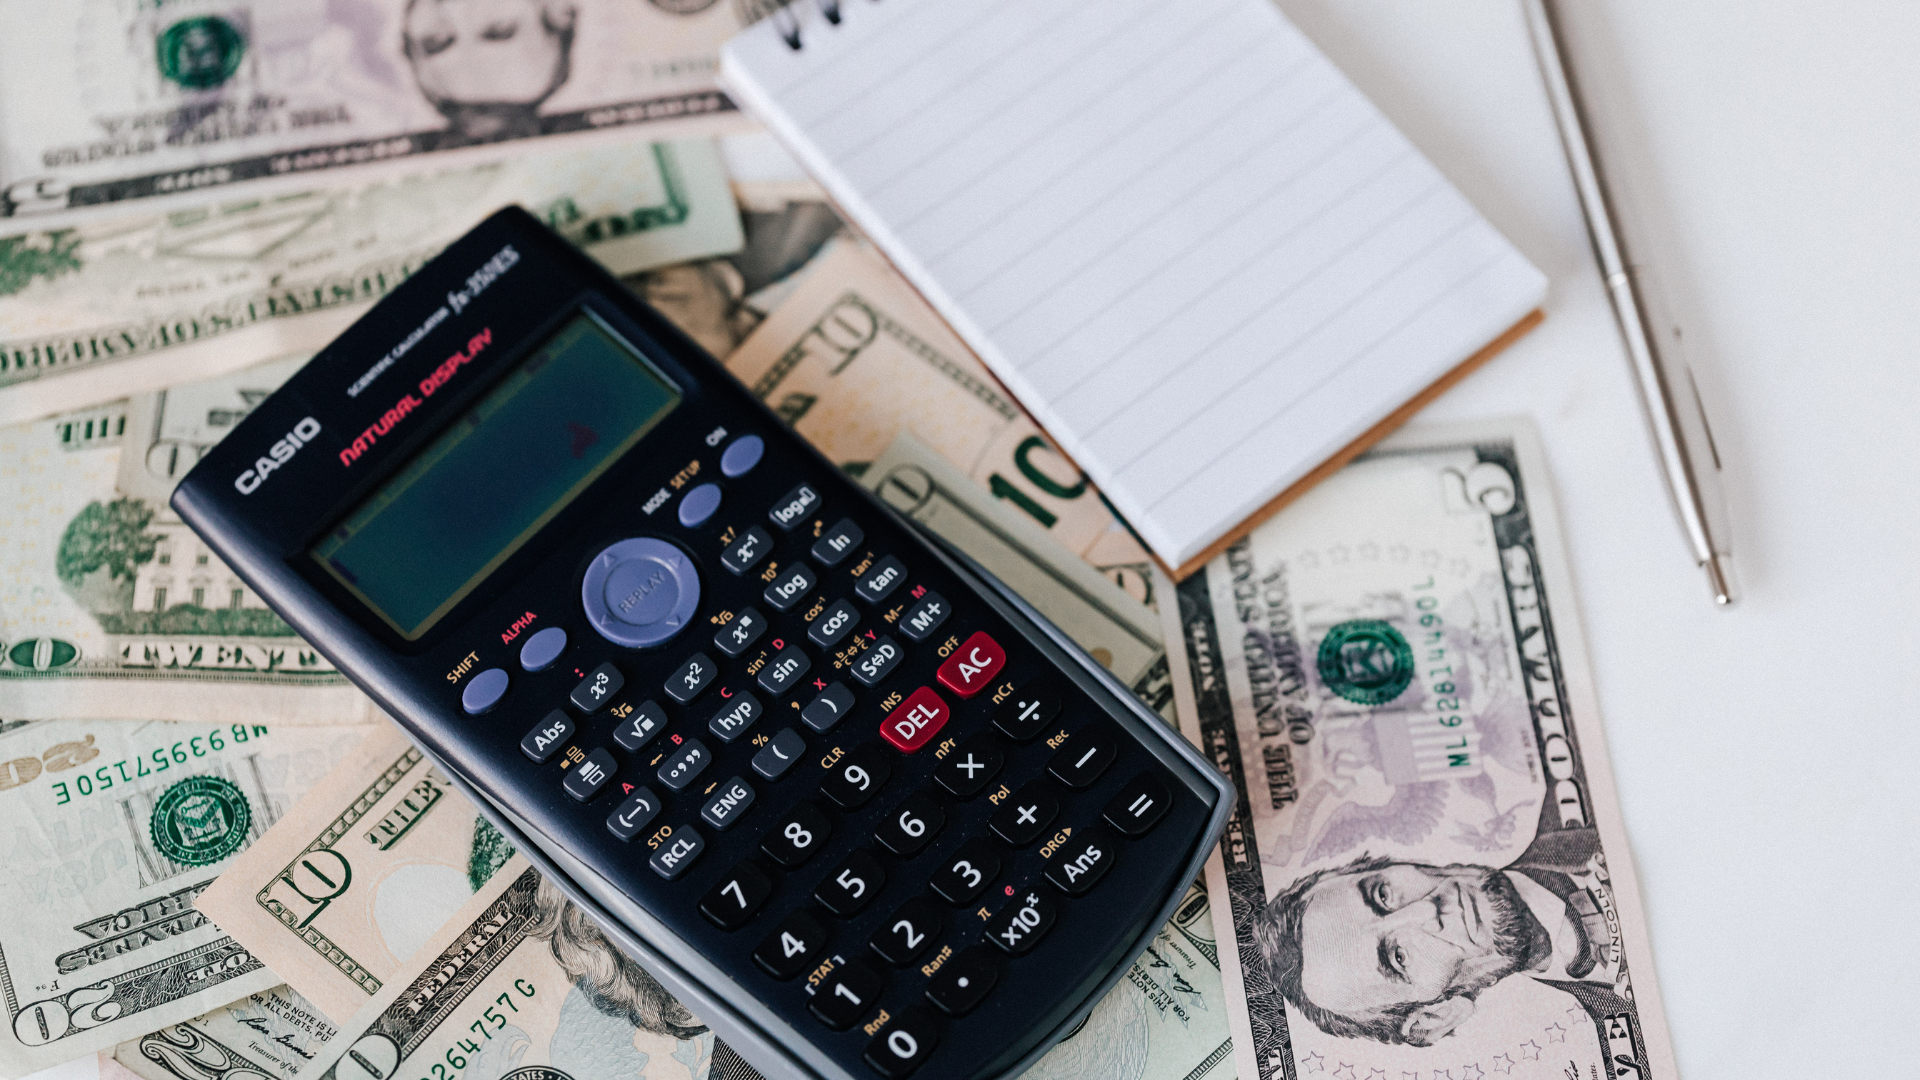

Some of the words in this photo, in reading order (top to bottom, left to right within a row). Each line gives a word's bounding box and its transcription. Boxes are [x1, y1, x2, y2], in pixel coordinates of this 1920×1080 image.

[340, 393, 423, 467] NATURAL
[419, 327, 492, 398] DISPLAY
[705, 426, 728, 446] ON
[234, 416, 321, 495] CASIO
[641, 487, 672, 515] MODE
[670, 459, 701, 490] SETUP
[1443, 461, 1516, 516] 5
[618, 571, 667, 614] REPLAY
[775, 573, 808, 600] log
[868, 566, 899, 593] tan
[911, 584, 927, 600] M
[500, 611, 537, 645] ALPHA
[822, 610, 849, 636] cos
[910, 601, 942, 632] M+
[772, 637, 785, 650] D
[864, 629, 877, 641] Y
[937, 635, 960, 659] OFF
[119, 640, 338, 675] TWENT
[446, 651, 480, 684] SHIFT
[773, 658, 799, 683] sin
[958, 647, 993, 684] AC
[1416, 595, 1463, 728] 62814490
[720, 686, 733, 699] C
[991, 681, 1016, 705] nCr
[1243, 629, 1285, 740] UNITED
[1501, 544, 1590, 829] DOLLARS
[717, 701, 753, 731] hyp
[879, 691, 902, 713] INS
[534, 720, 566, 751] Abs
[895, 702, 940, 740] DEL
[1285, 704, 1316, 745] OF
[671, 733, 683, 746] B
[752, 733, 769, 747] %
[934, 737, 957, 761] nPr
[1046, 729, 1070, 751] Rec
[1446, 735, 1471, 768] ML
[76, 729, 225, 796] 93957150
[820, 747, 845, 770] CLR
[621, 782, 634, 795] A
[844, 764, 871, 791] 9
[1263, 743, 1299, 811] THE
[51, 781, 71, 806] E
[711, 784, 748, 820] ENG
[988, 784, 1011, 806] Pol
[363, 780, 444, 851] THE
[899, 810, 926, 838] 6
[647, 825, 673, 850] STO
[783, 822, 813, 849] 8
[660, 838, 696, 869] RCL
[1062, 843, 1102, 884] Ans
[836, 868, 866, 899] 5
[952, 860, 982, 888] 3
[281, 849, 353, 930] 10
[720, 879, 748, 909] 7
[892, 919, 925, 950] 2
[1594, 887, 1621, 963] LINCOLN
[408, 905, 519, 1015] FEDERAL
[780, 931, 807, 959] 4
[1169, 941, 1197, 970] Treasurer
[184, 951, 251, 984] OTE
[920, 945, 953, 978] Ran#
[514, 978, 536, 998] G
[834, 982, 862, 1006] 1
[1127, 971, 1150, 994] NOTE
[1159, 988, 1175, 1005] ALL
[12, 979, 122, 1047] 20
[250, 993, 264, 1005] OR
[264, 1002, 280, 1015] ALL
[270, 993, 291, 1010] THIS
[291, 1006, 317, 1025] NOTE
[316, 1021, 326, 1031] IS
[1148, 991, 1168, 1012] THIS
[1173, 1004, 1190, 1022] FOR
[862, 1009, 891, 1037] Rnd
[248, 1040, 281, 1063] Treasurer
[280, 1060, 290, 1071] of
[887, 1029, 919, 1059] 0
